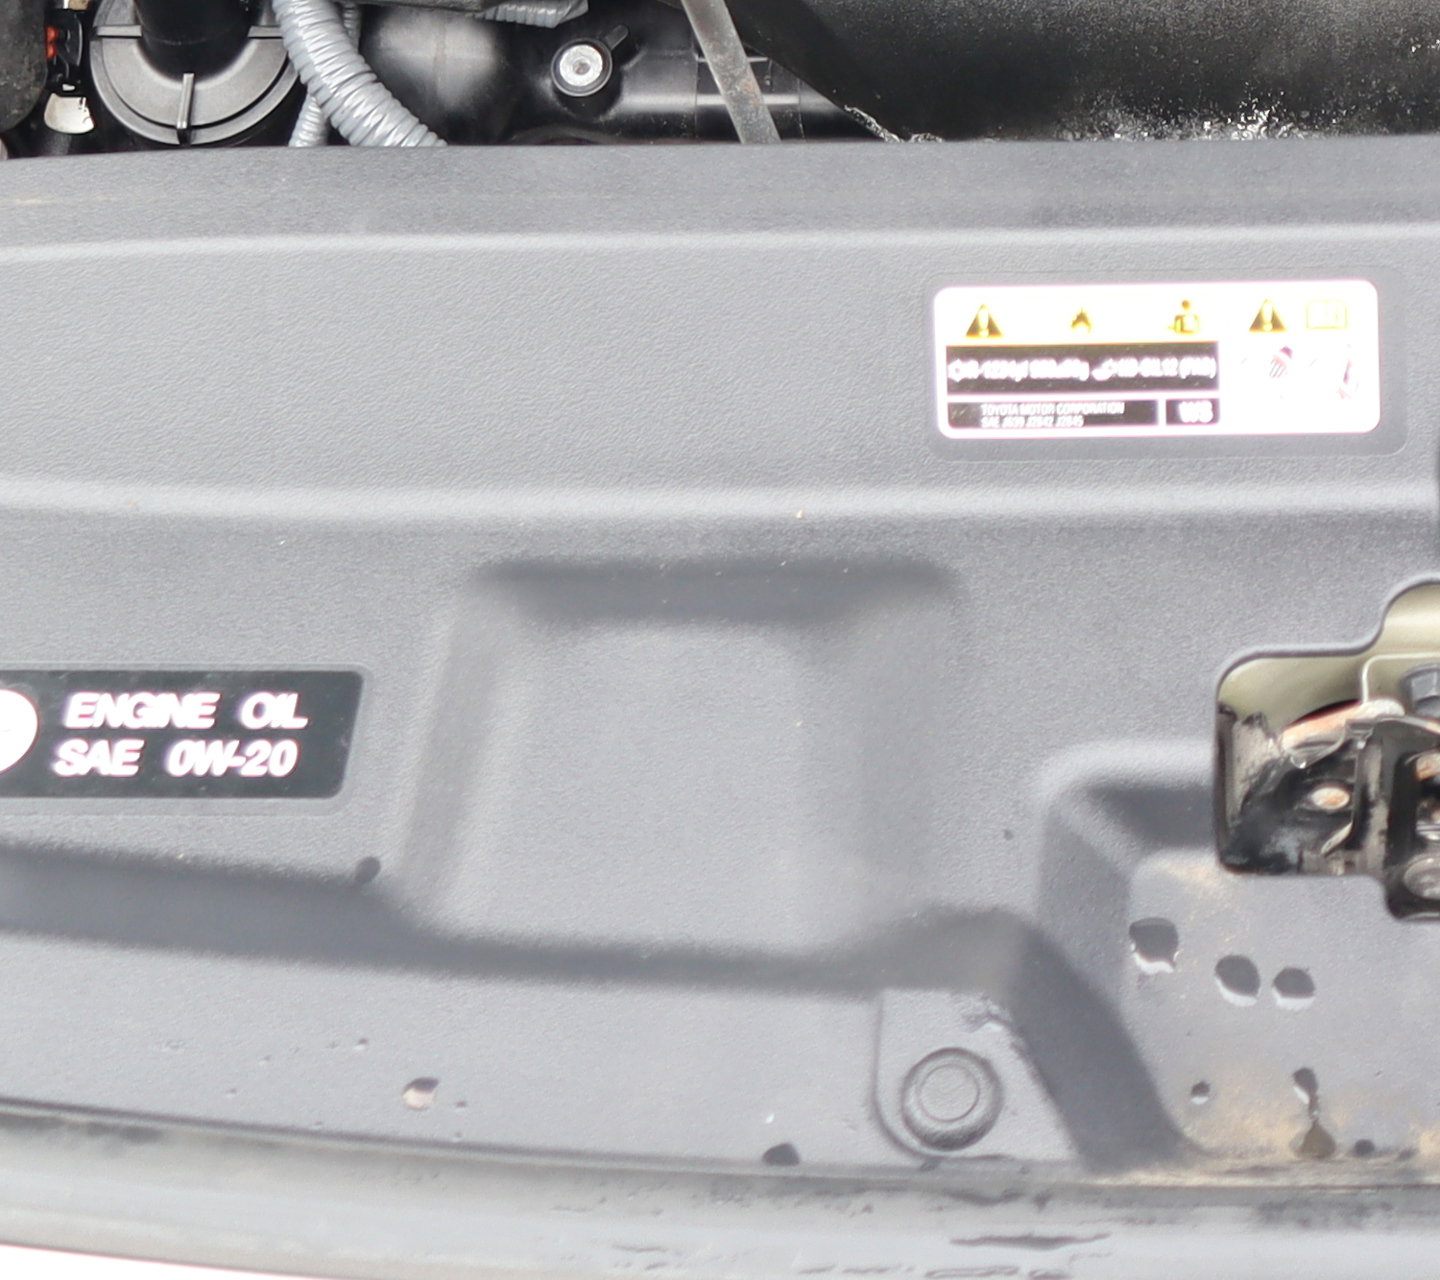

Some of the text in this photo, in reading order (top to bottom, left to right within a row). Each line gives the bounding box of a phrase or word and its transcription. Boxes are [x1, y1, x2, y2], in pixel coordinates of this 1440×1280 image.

[981, 401, 1125, 416] TOYOTA MOTOR CORPORATION
[63, 692, 309, 729] ENGINE OIL
[53, 739, 299, 777] SAE 0W-20
